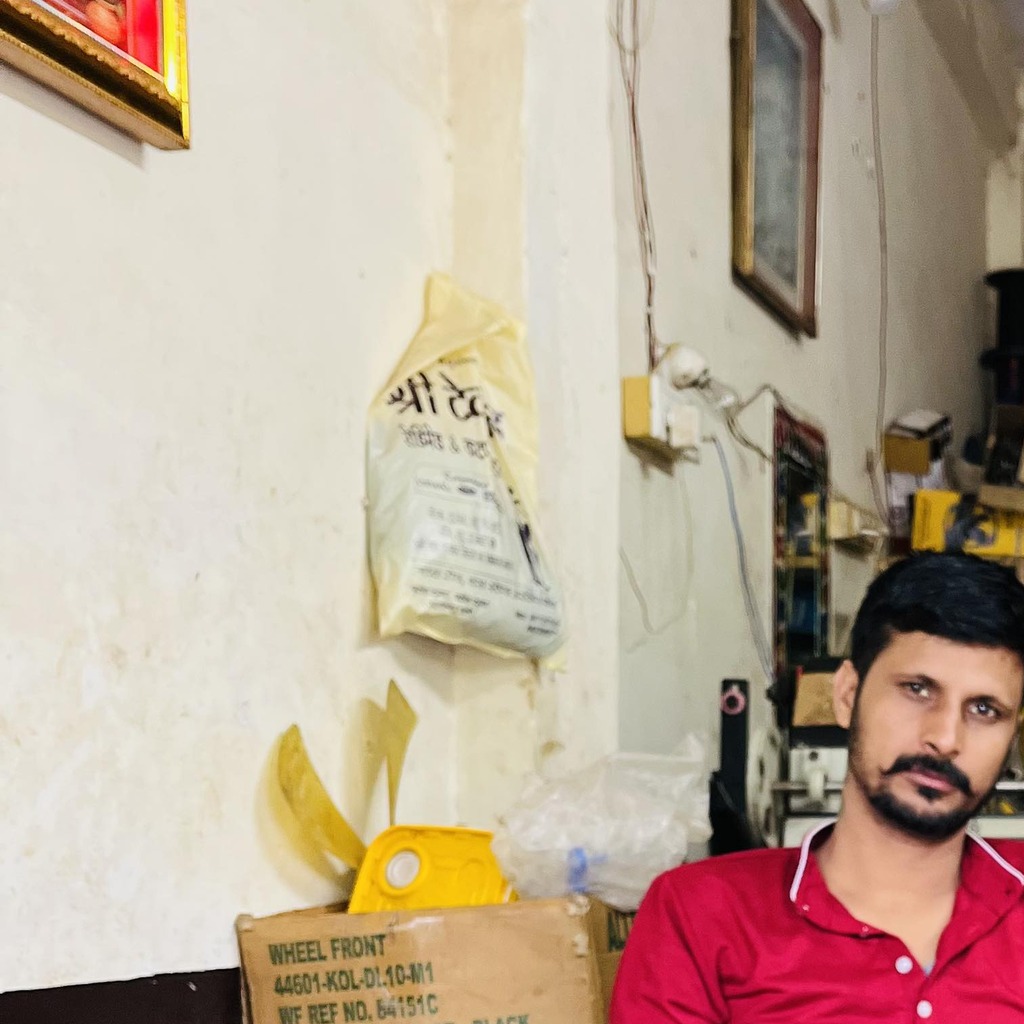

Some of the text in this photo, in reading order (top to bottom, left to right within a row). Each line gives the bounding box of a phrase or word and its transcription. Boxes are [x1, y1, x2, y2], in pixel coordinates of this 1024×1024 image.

[268, 934, 387, 965] WHEEL FRONT
[307, 1003, 338, 1024] REF
[343, 1000, 373, 1023] NO.
